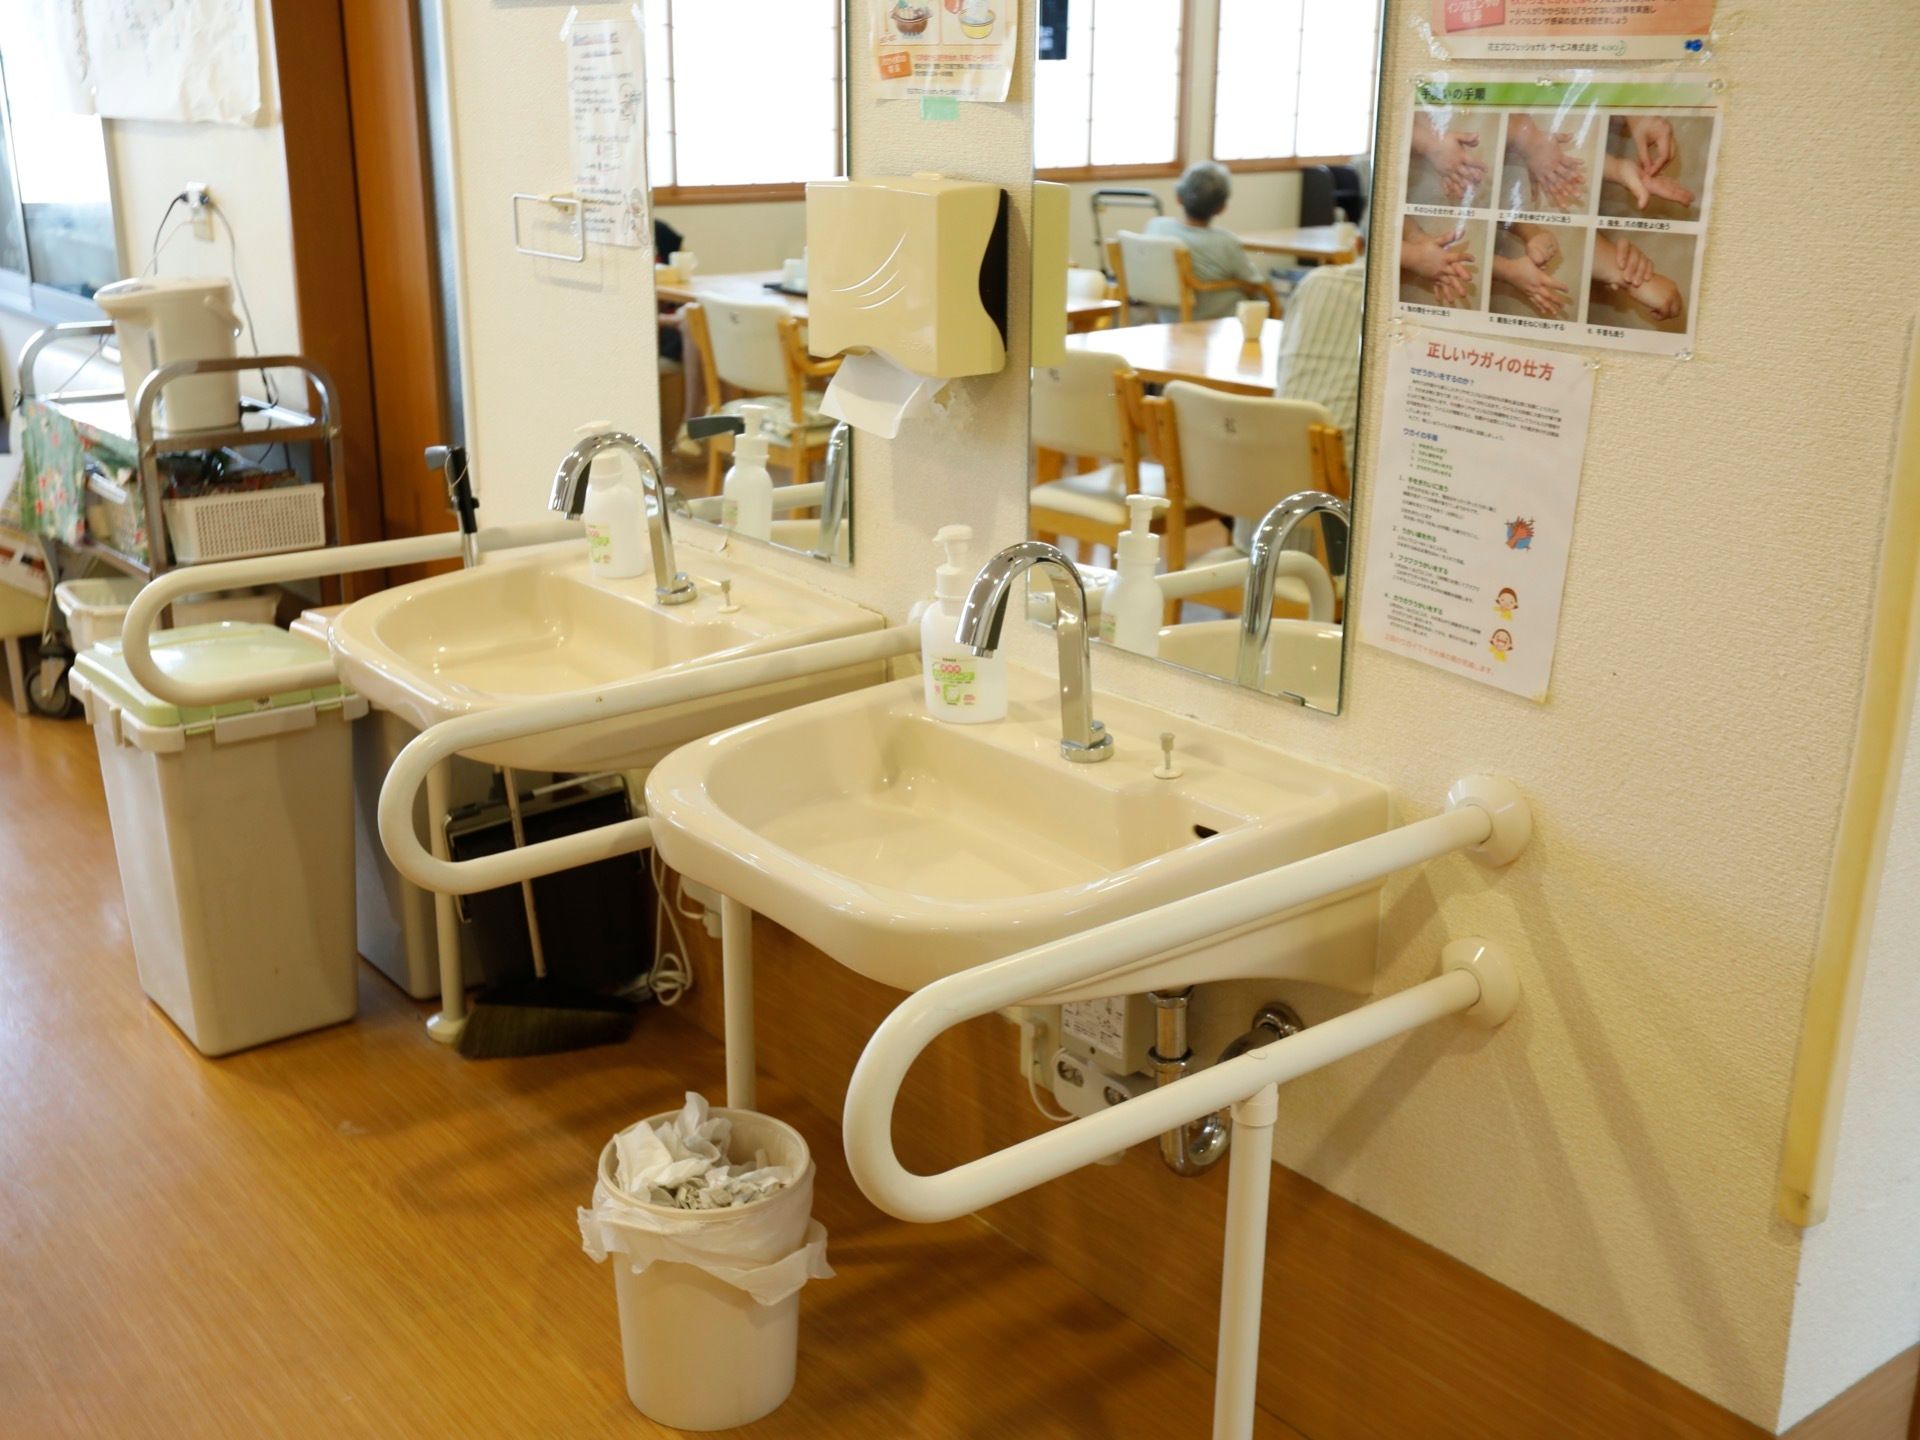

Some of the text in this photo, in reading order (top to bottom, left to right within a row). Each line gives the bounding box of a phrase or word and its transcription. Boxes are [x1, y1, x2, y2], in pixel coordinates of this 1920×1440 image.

[1426, 341, 1555, 382] 正しいウガイの仕方
